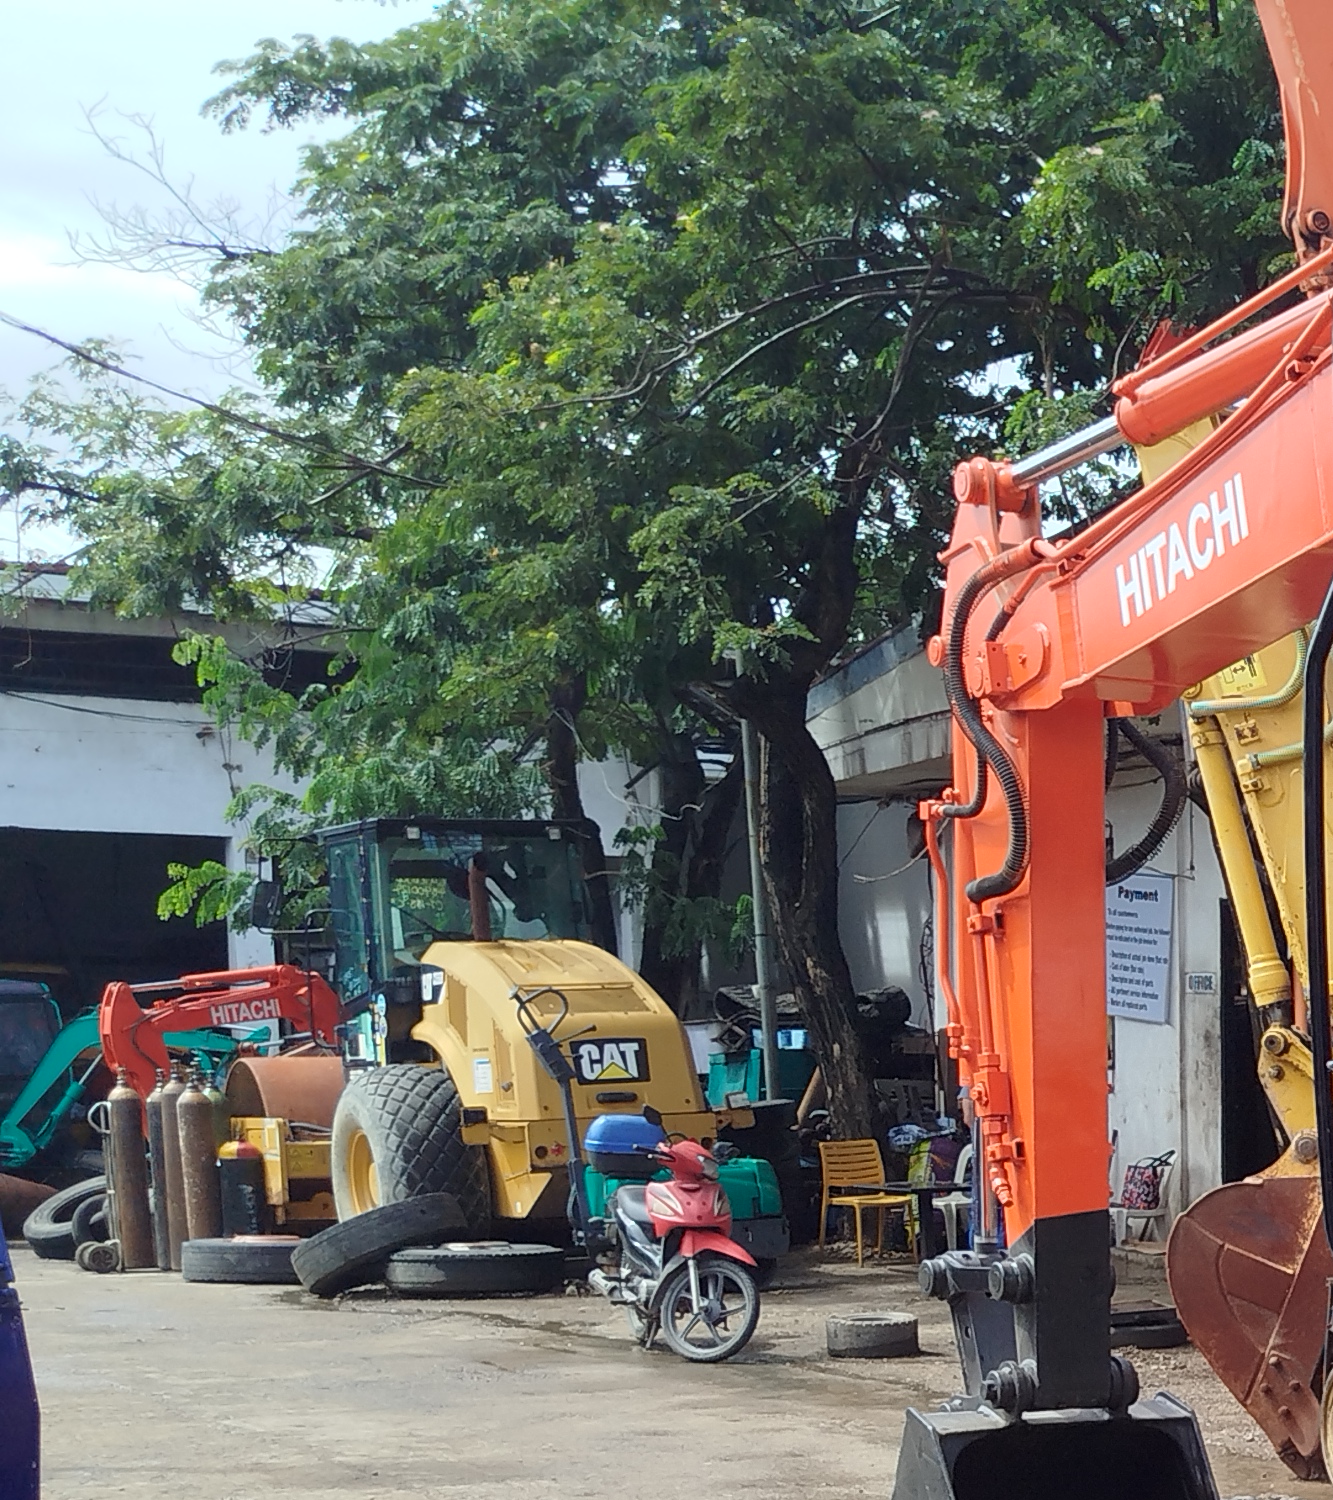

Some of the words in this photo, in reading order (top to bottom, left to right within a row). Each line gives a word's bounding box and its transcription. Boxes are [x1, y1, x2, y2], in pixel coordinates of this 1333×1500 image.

[1115, 472, 1249, 628] HITACHI
[1118, 886, 1159, 902] Payment
[1188, 974, 1213, 991] OFFICE
[210, 998, 282, 1025] HITACHI
[578, 1042, 640, 1081] CAT
